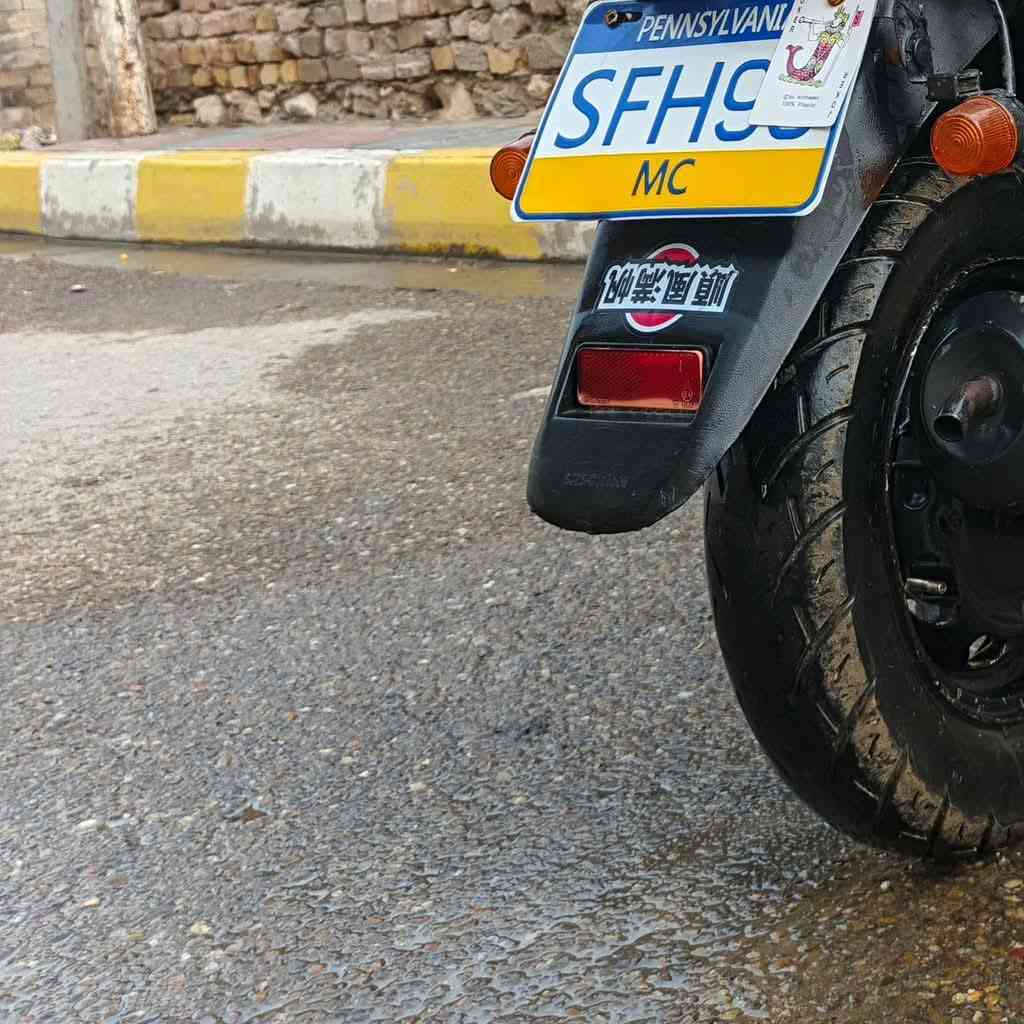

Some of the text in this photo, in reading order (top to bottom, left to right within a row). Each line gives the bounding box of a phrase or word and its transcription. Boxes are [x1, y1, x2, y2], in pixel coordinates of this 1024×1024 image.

[636, 2, 791, 43] PENNSYLVANI
[554, 58, 812, 149] SFH9
[631, 159, 696, 197] MC
